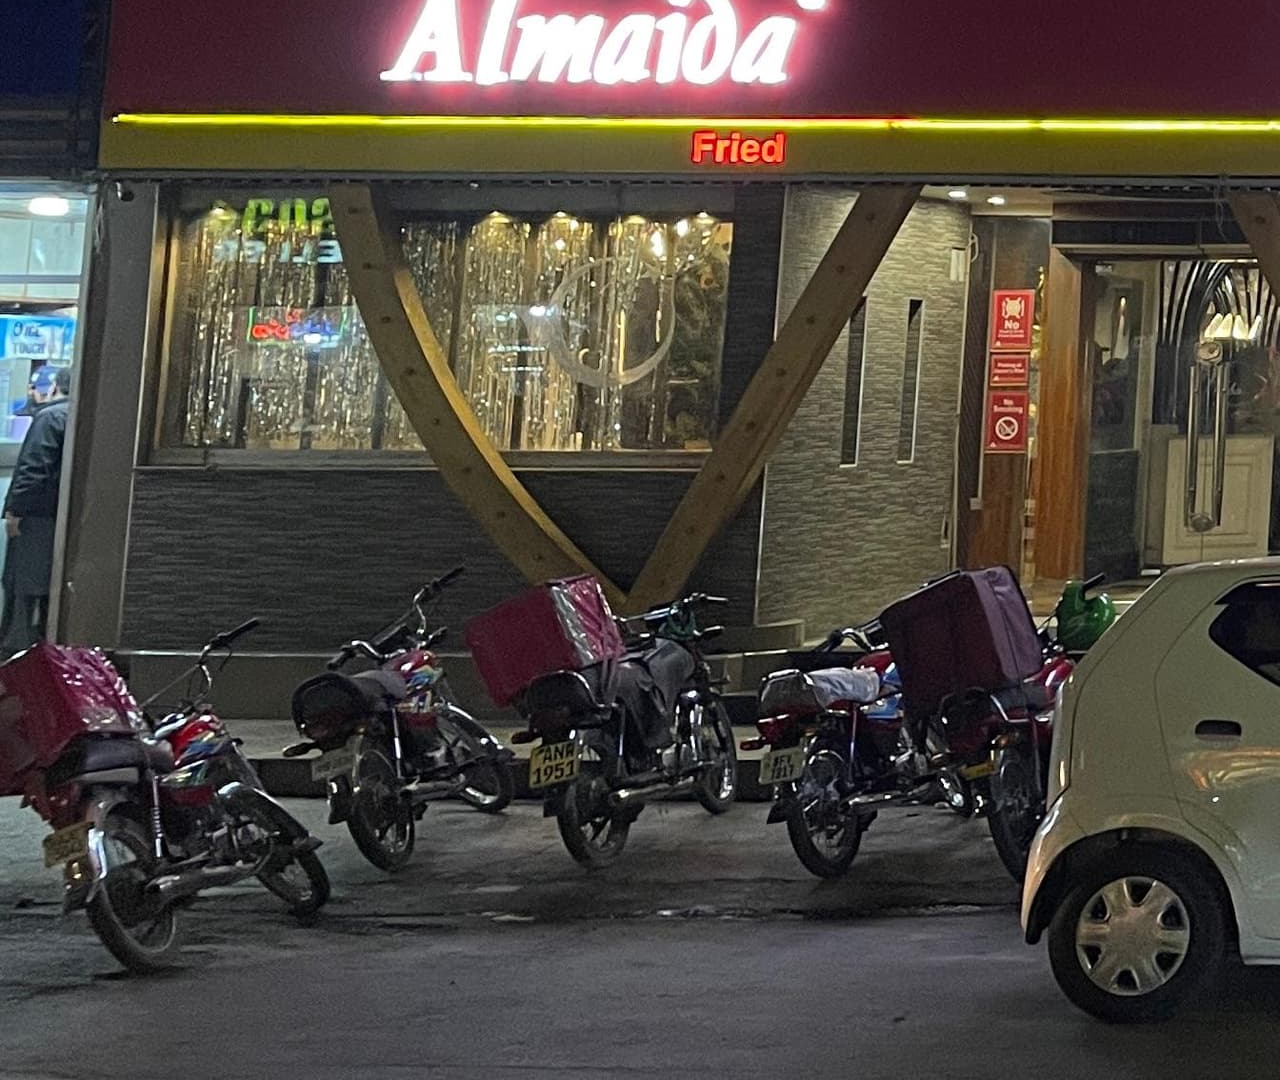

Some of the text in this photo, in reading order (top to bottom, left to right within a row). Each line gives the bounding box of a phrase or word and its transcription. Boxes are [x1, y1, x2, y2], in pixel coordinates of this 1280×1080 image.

[691, 131, 787, 164] Fried
[1004, 320, 1020, 330] No
[532, 760, 575, 785] 1951
